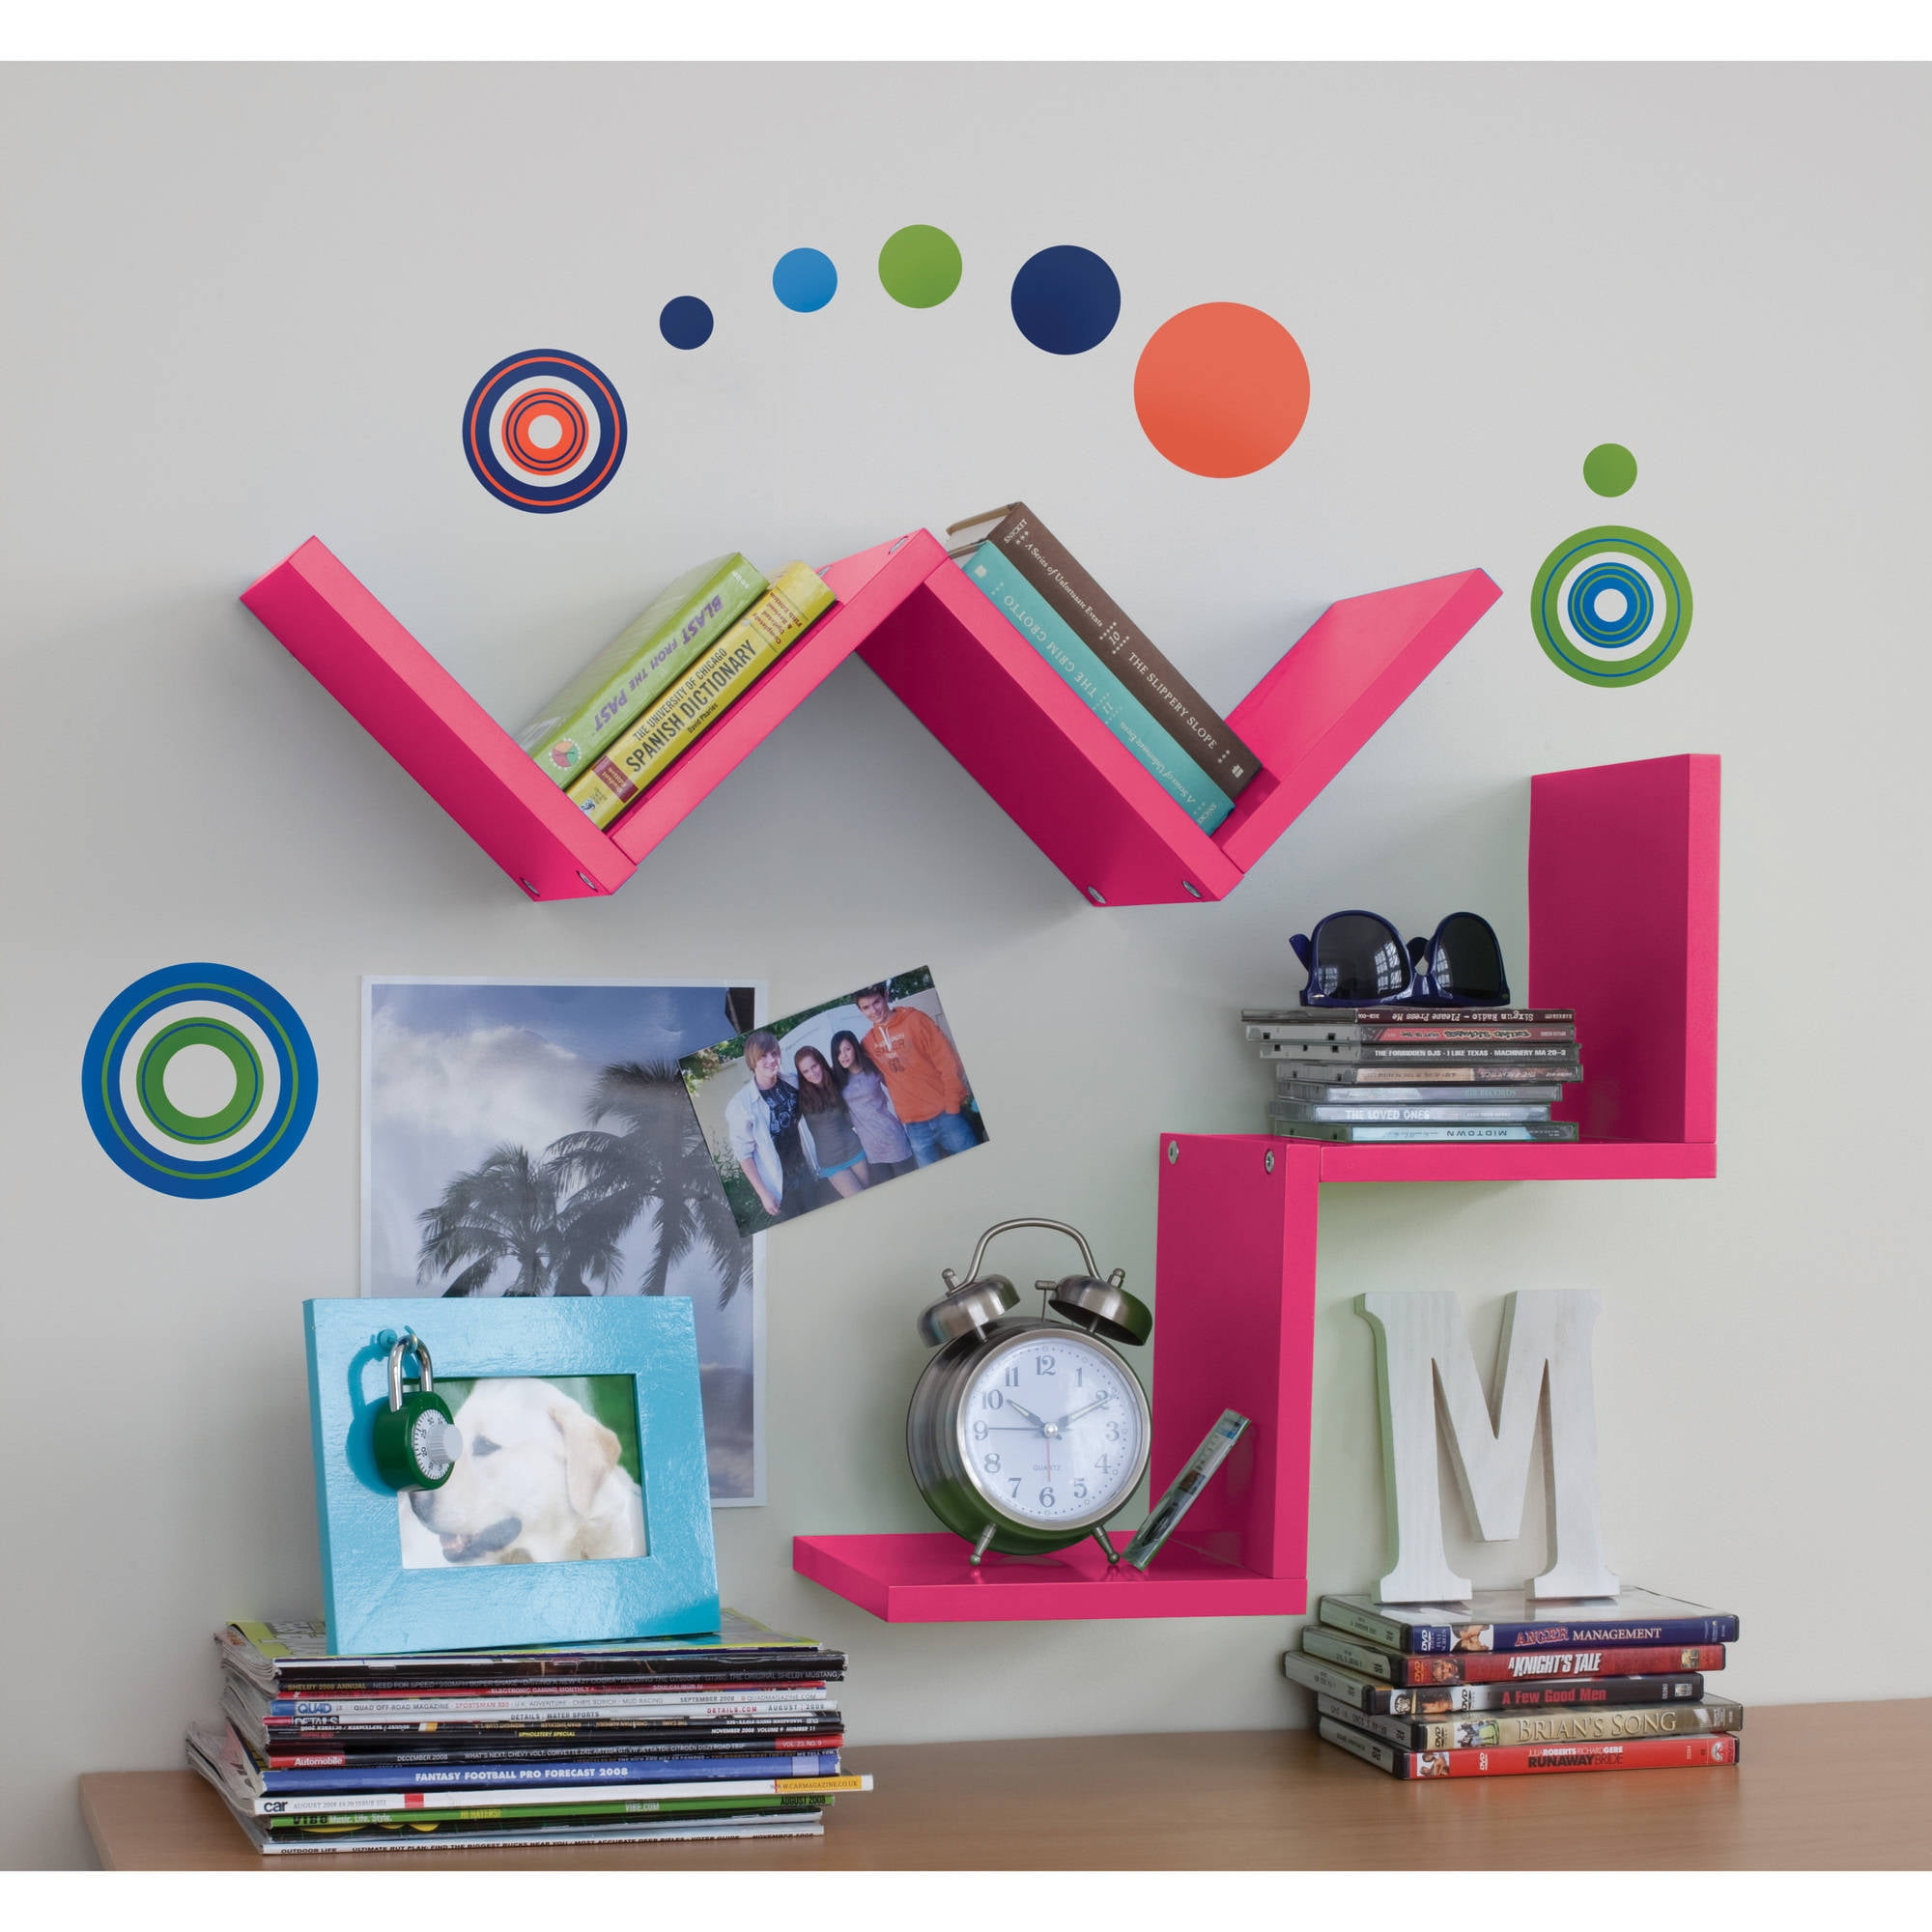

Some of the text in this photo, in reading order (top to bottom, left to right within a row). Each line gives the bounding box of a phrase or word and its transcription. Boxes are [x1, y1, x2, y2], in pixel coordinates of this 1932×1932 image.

[1031, 548, 1048, 568] Series
[1047, 567, 1059, 577] of
[1055, 572, 1087, 610] Unfortunate
[1084, 606, 1103, 628] Events
[1004, 595, 1097, 698] THE GRIM GROTTO
[1108, 631, 1121, 645] 10
[594, 594, 724, 733] BLAST FROM THE PAST
[633, 647, 727, 742] THE UNIVERSITY OF CHICAGO
[1128, 651, 1218, 750] THE SLIPPERY SLOPE
[626, 639, 757, 773] SPANISH DICTIONARY
[1406, 1012, 1429, 1021] Press
[1432, 1012, 1461, 1021] Please
[1471, 1012, 1497, 1021] Radio
[1500, 1010, 1534, 1022] Sixgun
[1345, 1110, 1430, 1121] THE LOVED ONES
[1036, 1355, 1056, 1376] 12
[1005, 1367, 1020, 1387] 11
[1076, 1367, 1083, 1388] 1
[981, 1389, 1004, 1409] 10
[1095, 1389, 1111, 1410] 2
[973, 1420, 988, 1441] 9
[1106, 1421, 1121, 1441] 3
[984, 1453, 1001, 1473] 8
[1094, 1453, 1111, 1474] 4
[1008, 1477, 1022, 1498] 7
[1038, 1487, 1055, 1508] 6
[1073, 1477, 1088, 1498] 5
[1421, 1630, 1430, 1652] DVD
[1514, 1627, 1662, 1647] ANGER MANAGEMENT
[1507, 1653, 1603, 1677] A KNIGHT'S TALE
[1501, 1688, 1607, 1705] A Few Good Men
[298, 1702, 332, 1714] QUAD
[1517, 1712, 1678, 1743] BRIAN'S SONG
[295, 1756, 343, 1766] Automobile
[1527, 1754, 1623, 1768] RUNAWAY BRIDE
[1543, 1747, 1577, 1756] ROBERTS
[1603, 1746, 1623, 1754] GERE
[415, 1768, 629, 1781] FANTASY FOOTBALL PRO FORECAST 2008
[263, 1801, 288, 1812] car
[781, 1797, 808, 1805] AUGUST
